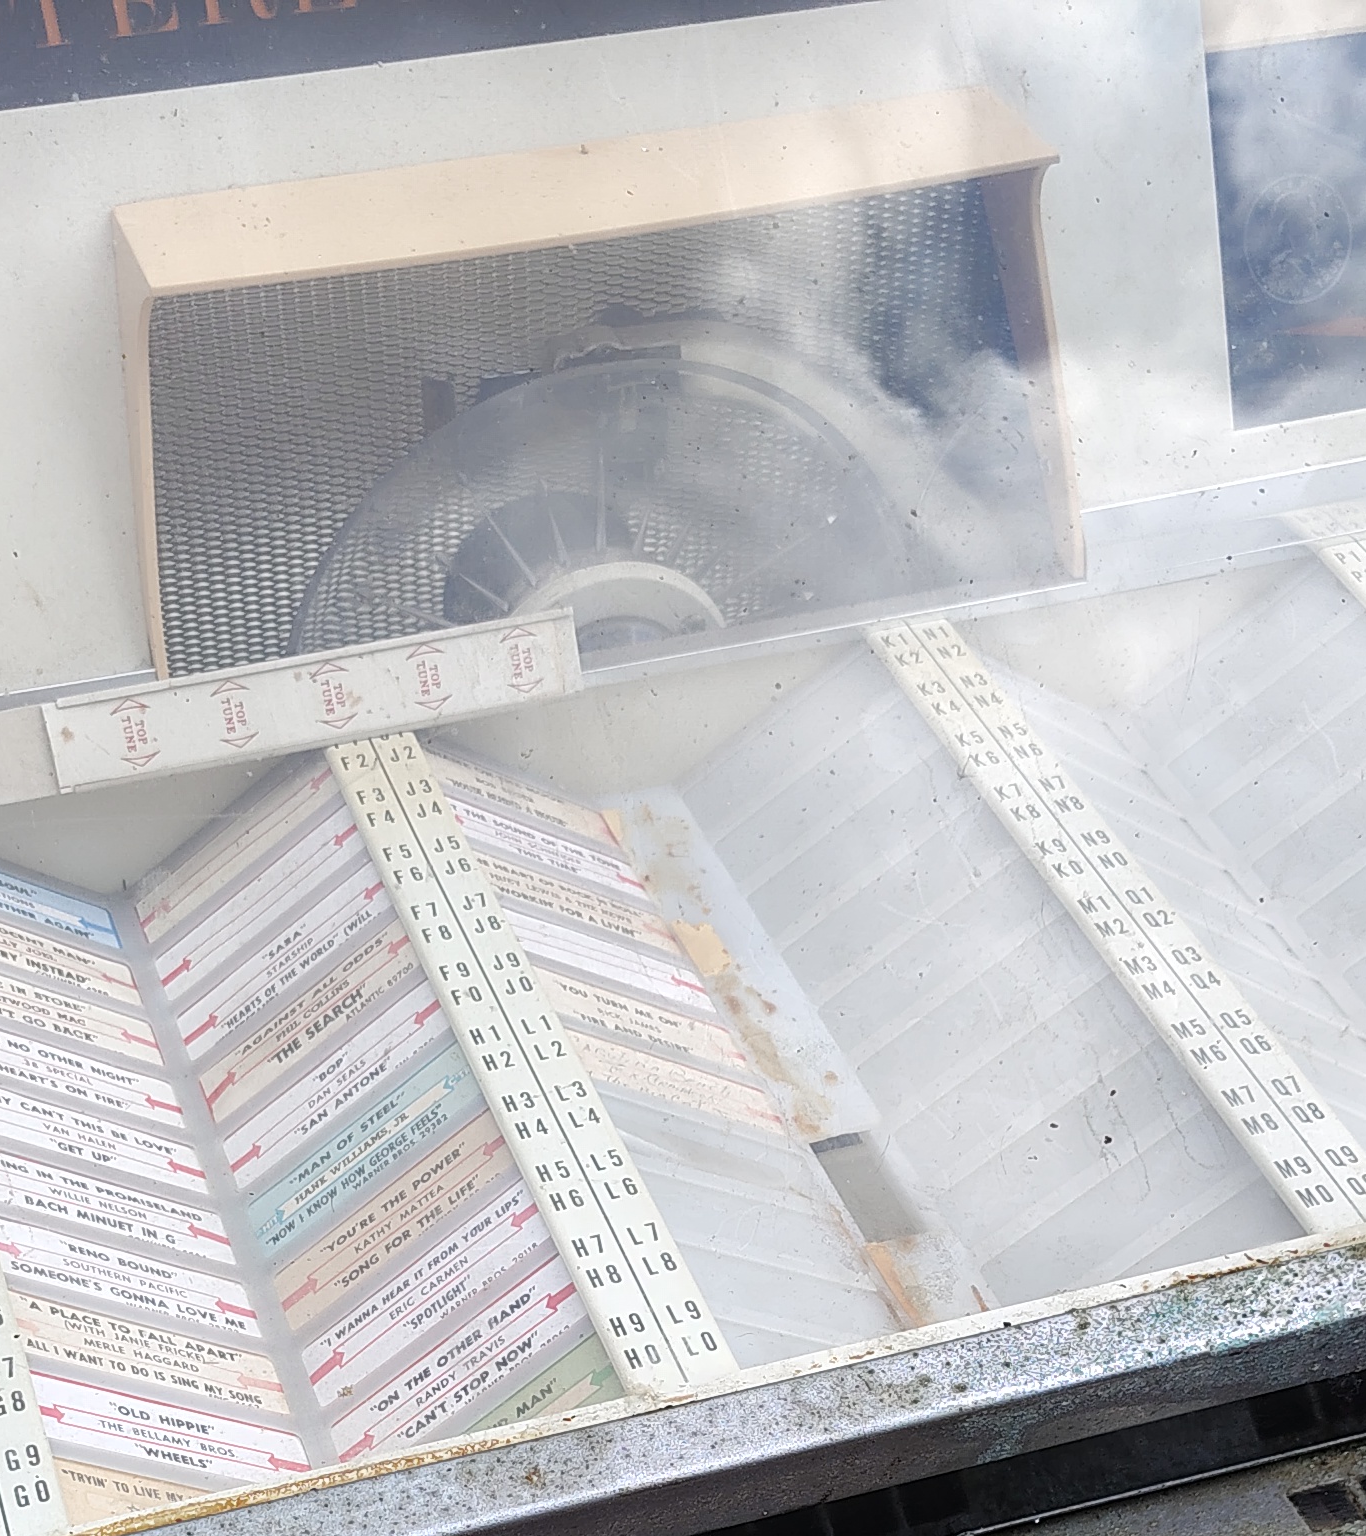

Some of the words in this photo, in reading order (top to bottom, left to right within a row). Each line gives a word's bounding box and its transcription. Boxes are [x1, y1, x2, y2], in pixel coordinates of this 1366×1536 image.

[416, 661, 430, 698] TUNE
[429, 664, 441, 689] TOP
[508, 644, 524, 680] TUNE
[521, 648, 535, 672] TOP
[220, 696, 235, 734] TUNE
[234, 701, 246, 726] TOP
[320, 679, 335, 716] TUNE
[333, 682, 345, 709] TOP
[121, 715, 136, 754] TUNE
[135, 720, 147, 745] TOP
[261, 924, 306, 961] "SARA"
[266, 937, 314, 978] STARSHIP
[344, 983, 385, 1023] ATLANTIC
[266, 1038, 304, 1067] "THE
[306, 982, 367, 1041] SEARCH"
[614, 1023, 641, 1039] AND
[8, 1038, 30, 1053] NO
[37, 1046, 83, 1069] OTHER
[289, 1155, 332, 1186] "MAN
[336, 1136, 356, 1153] OF
[360, 1091, 405, 1134] STEEL"
[320, 1212, 376, 1255] "YOU'RE
[381, 1188, 409, 1212] THE
[411, 1142, 465, 1191] POWER"
[24, 1195, 68, 1214] BACH
[75, 1208, 134, 1233] MINUET
[142, 1226, 159, 1240] IN
[165, 1232, 176, 1244] G
[333, 1251, 380, 1288] "SONG
[384, 1228, 413, 1254] FOR
[417, 1206, 444, 1230] THE
[447, 1174, 479, 1206] LIFE"
[353, 1222, 393, 1254] KATHY
[400, 1183, 444, 1221] MATTEA
[59, 1240, 111, 1263] "RENO
[117, 1256, 177, 1279] BOUND"
[62, 1258, 132, 1285] SOUTHERN
[139, 1279, 188, 1298] PACIFIC
[389, 1296, 415, 1321] ERIC
[420, 1255, 469, 1296] CARMEN
[403, 1274, 471, 1330] "SPOTLIGHT"
[369, 1390, 401, 1414] "ON
[404, 1367, 431, 1392] THE
[436, 1329, 484, 1368] OTHER
[488, 1285, 536, 1330] HAND"
[415, 1370, 457, 1407] RANDY
[464, 1334, 506, 1371] TRAVIS
[109, 1402, 152, 1421] "OLD
[159, 1414, 215, 1435] HIPPIE"
[98, 1419, 125, 1433] THE
[132, 1427, 191, 1449] BELLAMY
[199, 1442, 239, 1459] BROS.
[134, 1443, 213, 1469] "WHEELS"
